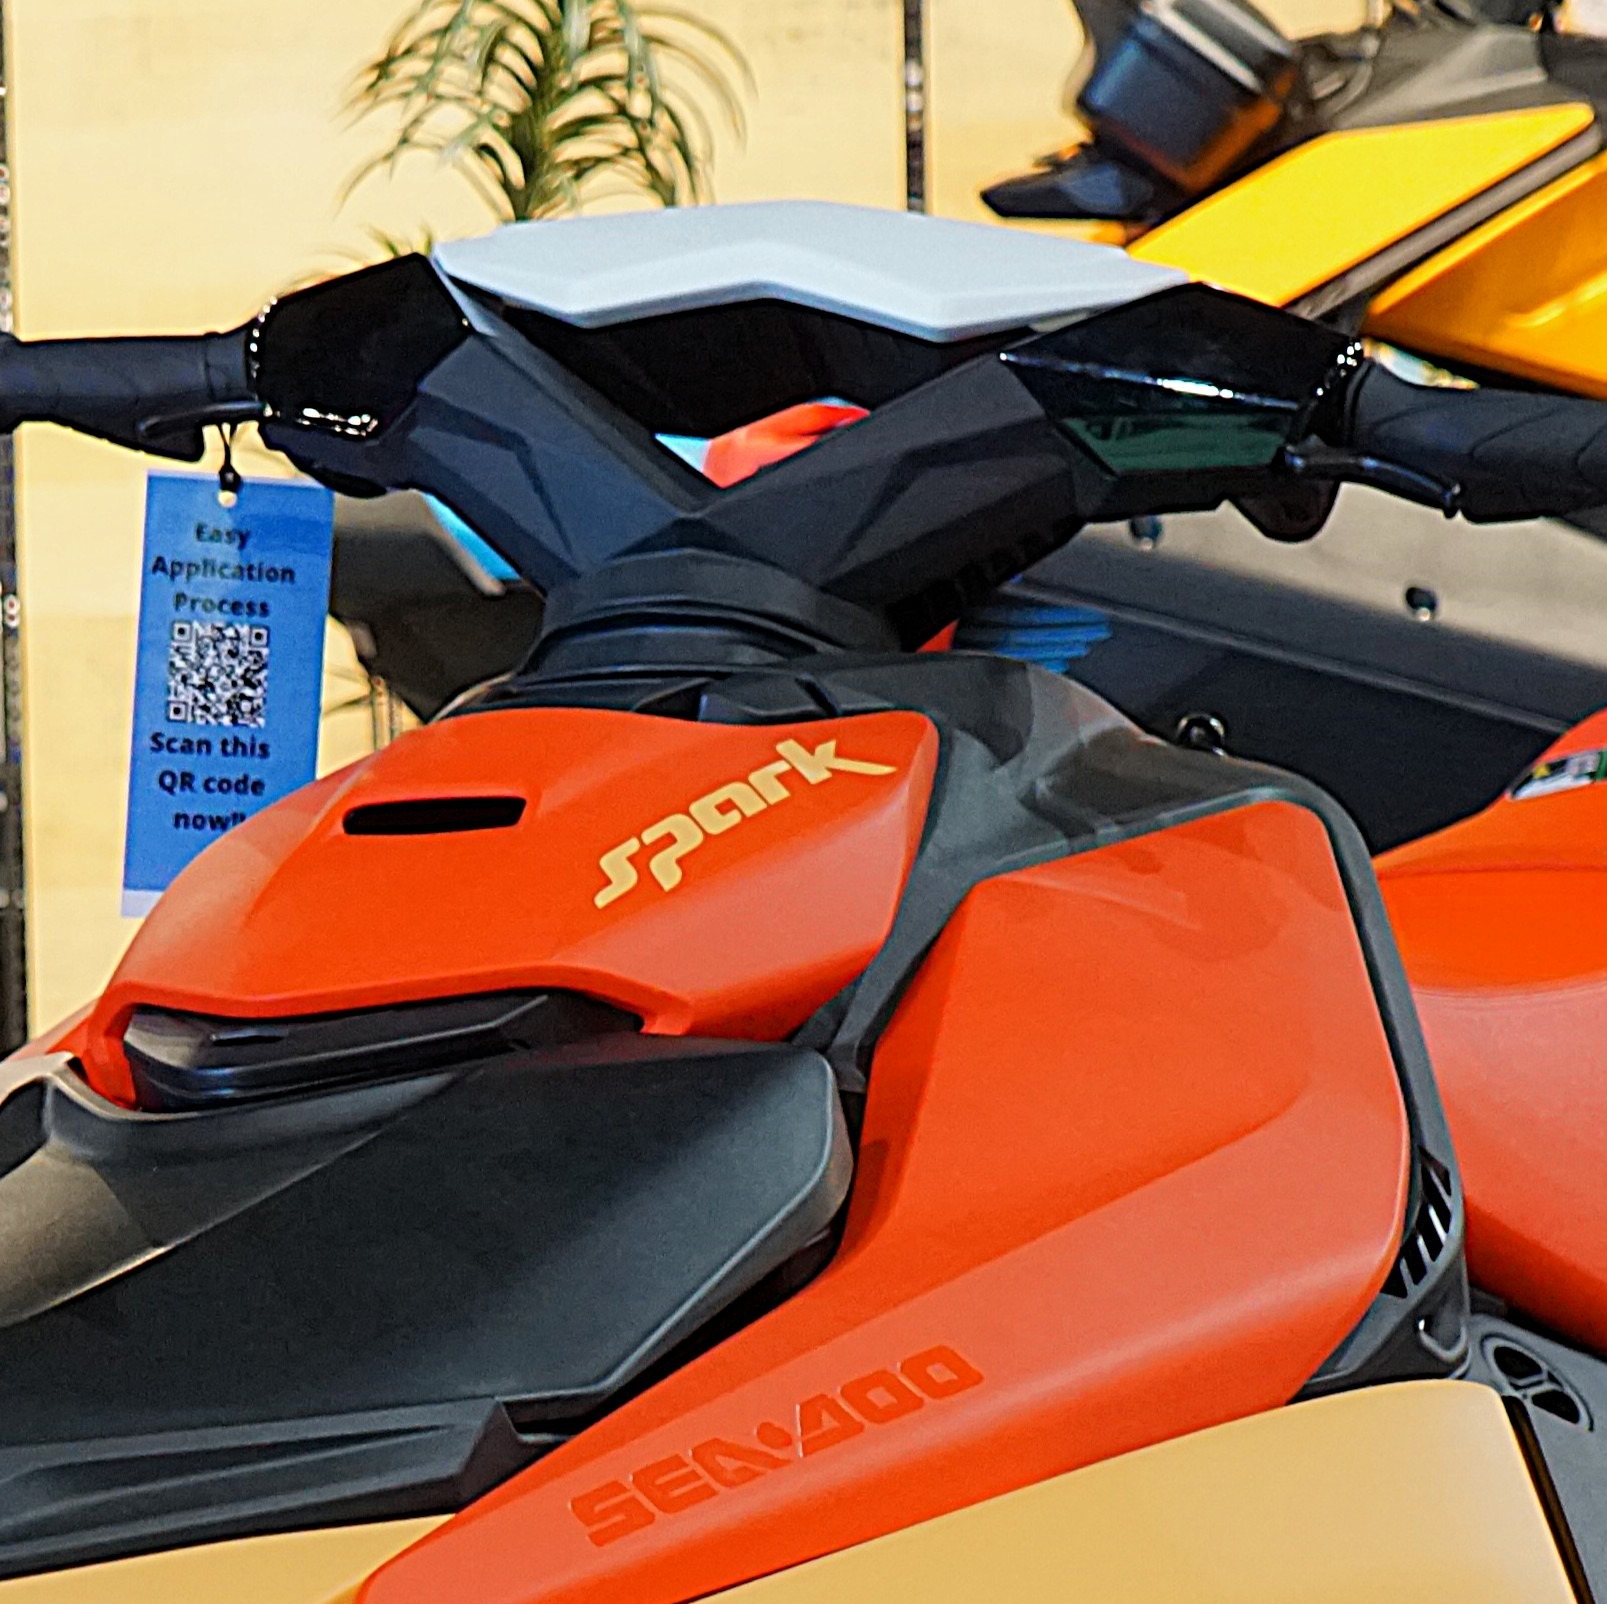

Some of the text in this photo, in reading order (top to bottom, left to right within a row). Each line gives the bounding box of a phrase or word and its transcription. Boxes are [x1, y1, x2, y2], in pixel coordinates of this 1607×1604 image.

[195, 522, 250, 550] Easy
[151, 556, 296, 583] Application
[174, 593, 269, 618] Process
[149, 731, 270, 760] Scan this
[158, 770, 265, 797] QR code
[594, 738, 897, 909] spark
